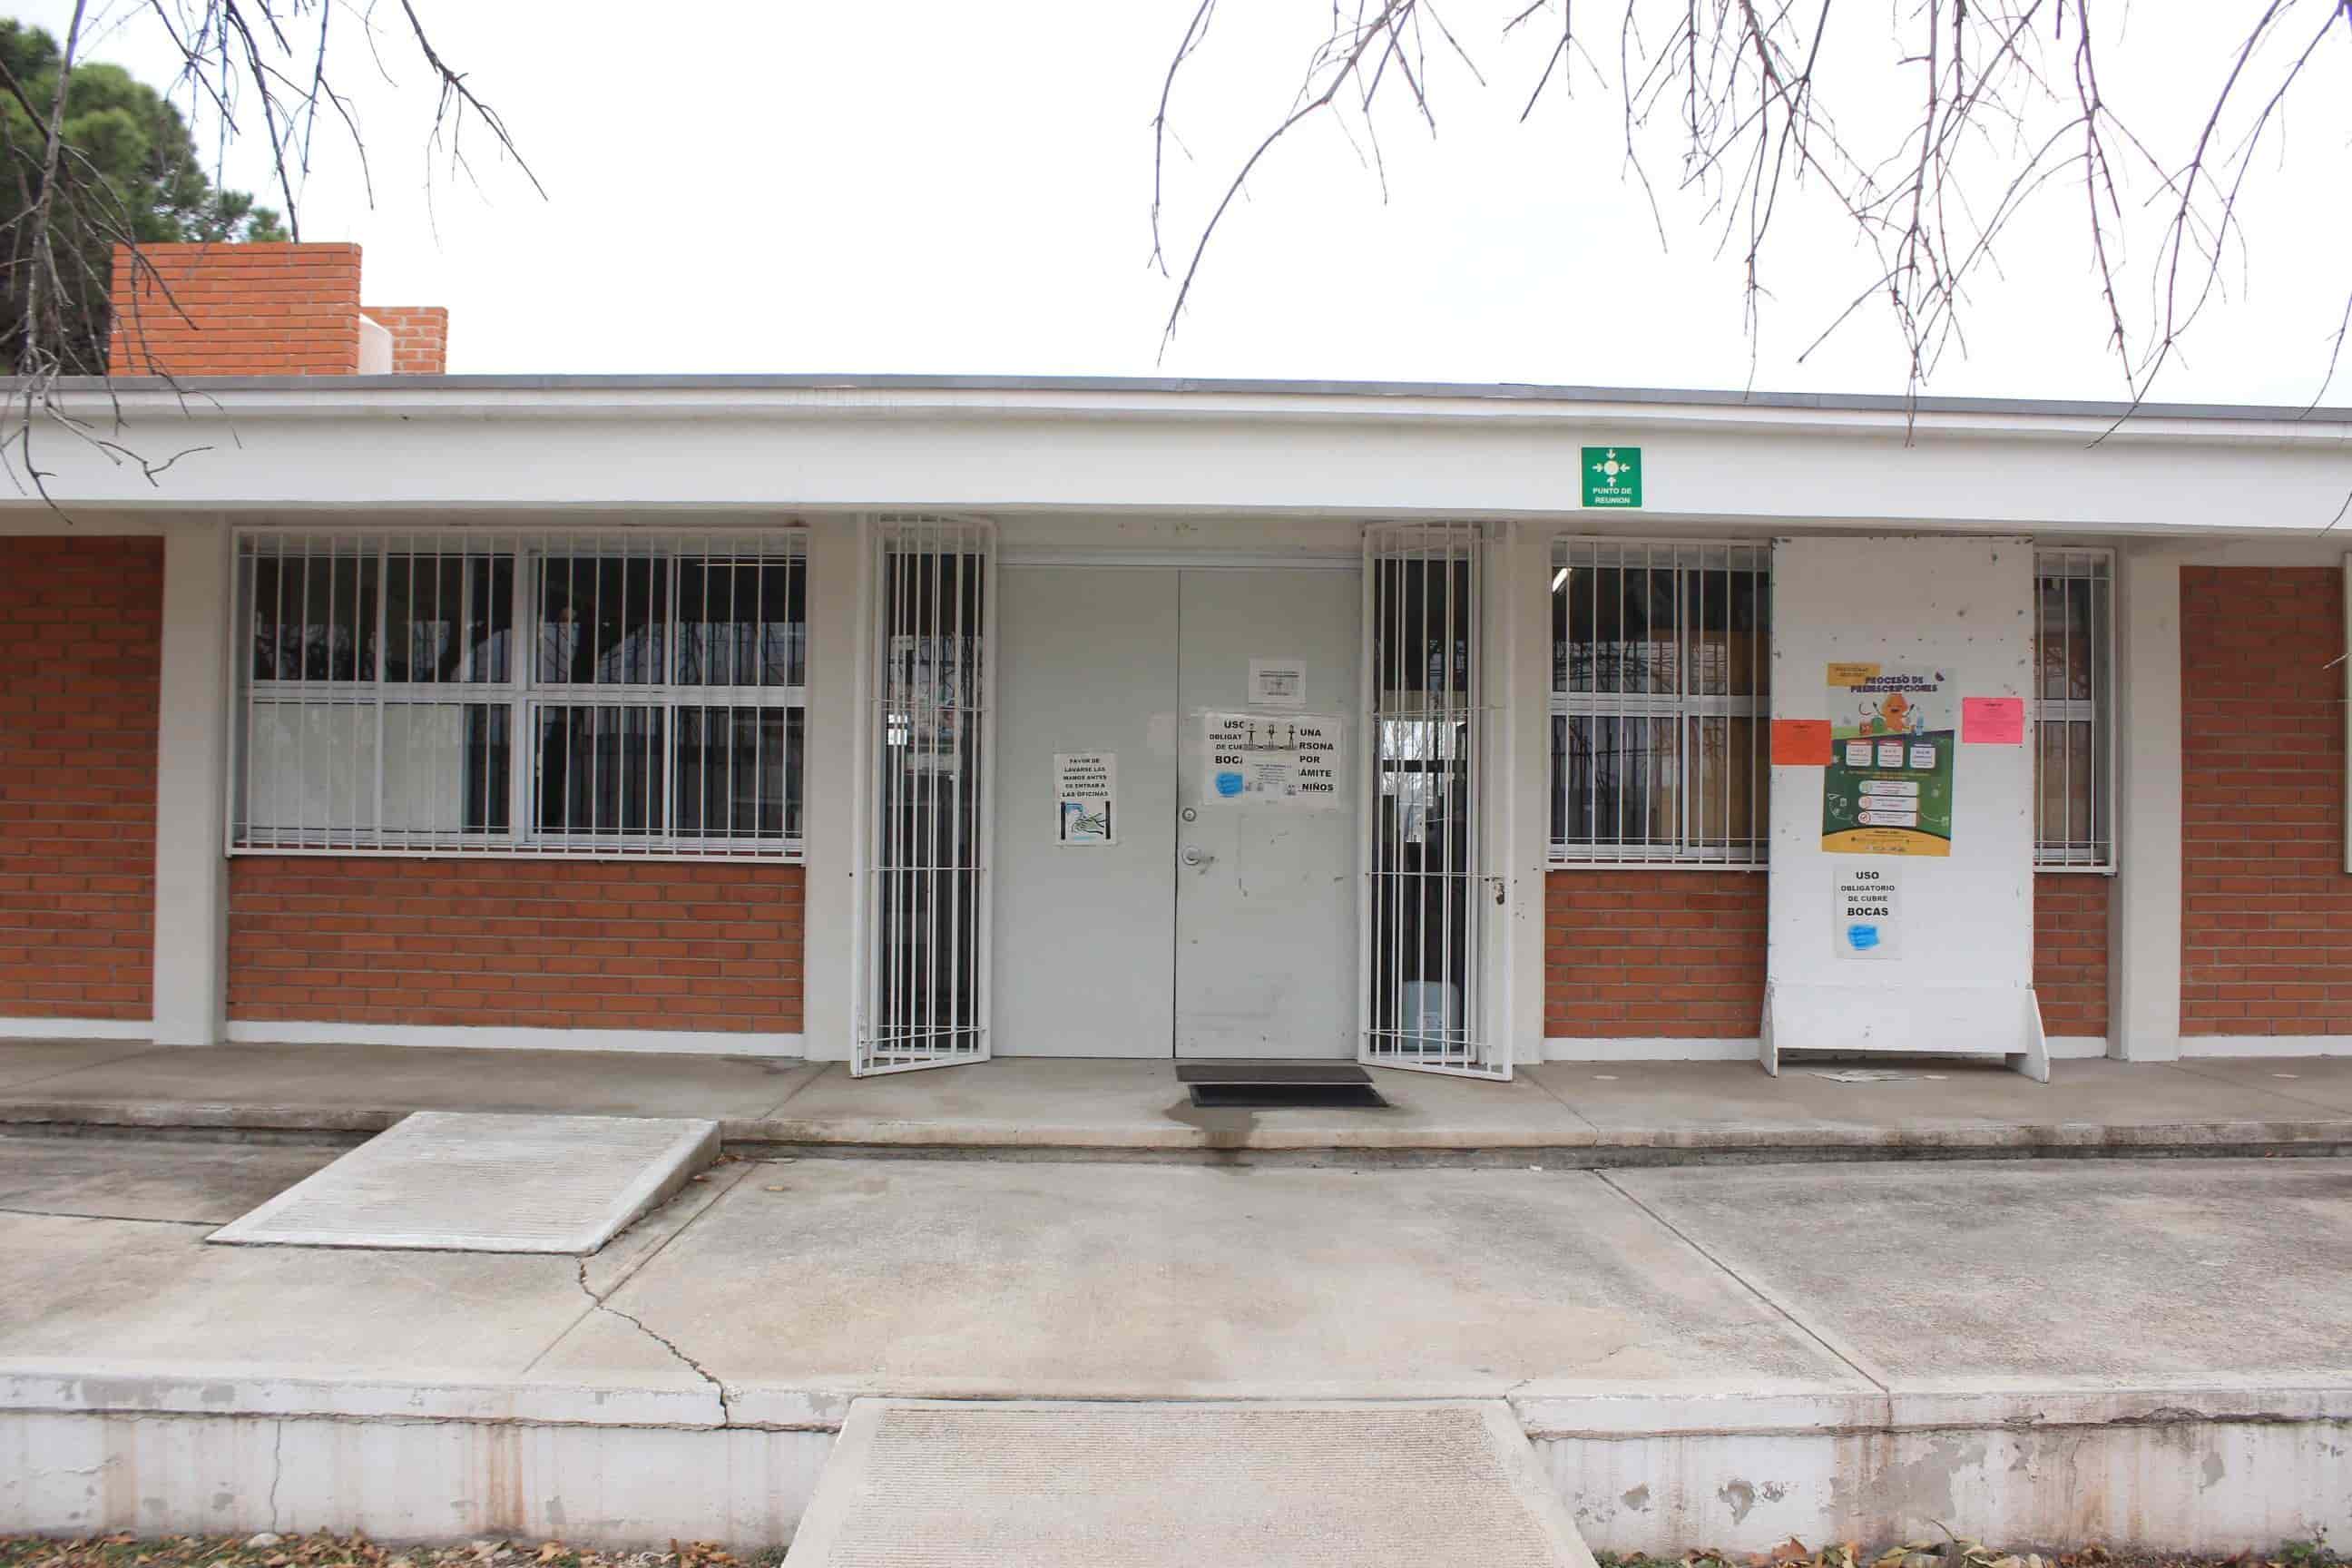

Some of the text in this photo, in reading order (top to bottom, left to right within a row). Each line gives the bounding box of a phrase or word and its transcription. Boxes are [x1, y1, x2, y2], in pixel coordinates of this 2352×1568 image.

[1865, 675, 1910, 683] PROCESO
[1299, 729, 1322, 737] UNA
[1298, 741, 1334, 750] RSONA
[1299, 755, 1321, 763] POR
[1855, 871, 1880, 879] USO
[1847, 906, 1889, 916] BOCAS
